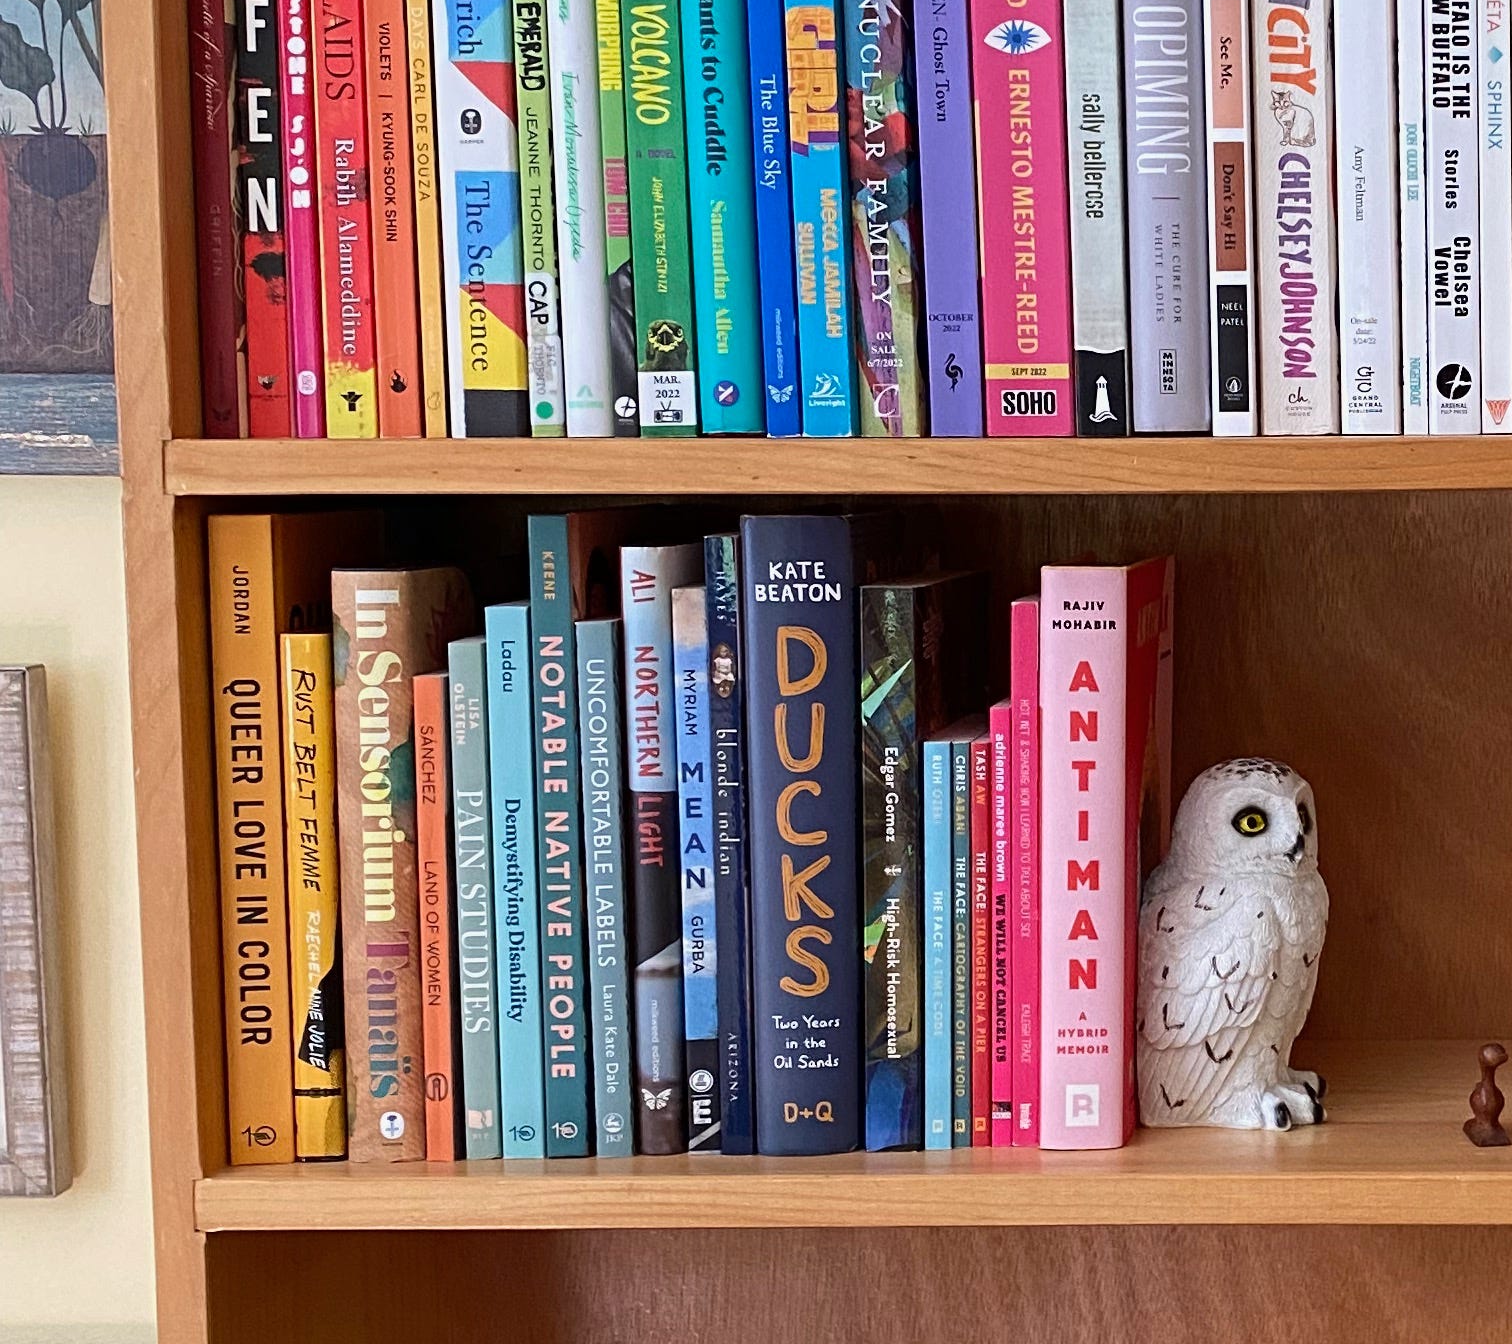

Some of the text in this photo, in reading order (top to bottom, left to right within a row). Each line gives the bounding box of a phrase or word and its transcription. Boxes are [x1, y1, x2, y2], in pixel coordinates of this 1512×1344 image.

[629, 3, 670, 124] VOLCANO
[700, 59, 716, 81] to
[700, 84, 723, 177] Cuddle
[334, 137, 357, 356] Rabih Alameddine
[867, 178, 892, 309] FAMILY
[528, 279, 549, 325] CAP
[929, 313, 974, 322] OCTOBER
[653, 375, 681, 386] MAR.
[654, 389, 681, 399] 2022
[1011, 367, 1046, 376] SEPT 2022
[1002, 390, 1056, 417] SOHO
[755, 582, 841, 602] BEATON
[769, 562, 825, 581] KATE
[232, 565, 251, 635] JORDAN
[1064, 601, 1104, 612] RAJIV
[1052, 619, 1116, 630] MOHABIR
[355, 585, 406, 923] In Sensorium
[420, 725, 436, 803] SÁNCHEZ
[775, 625, 832, 997] DUCKS
[1068, 660, 1100, 991] ANTIMAN
[226, 678, 271, 1046] QUEER LOVE IN COLOR
[539, 635, 576, 1079] NOTABLE NATIVE PEOPLE
[456, 790, 491, 1035] PAIN STUDIES
[366, 927, 418, 1100] Tanaïs
[773, 1015, 840, 1031] Two Years
[774, 1055, 839, 1069] Oil Sands
[786, 1035, 827, 1049] in the
